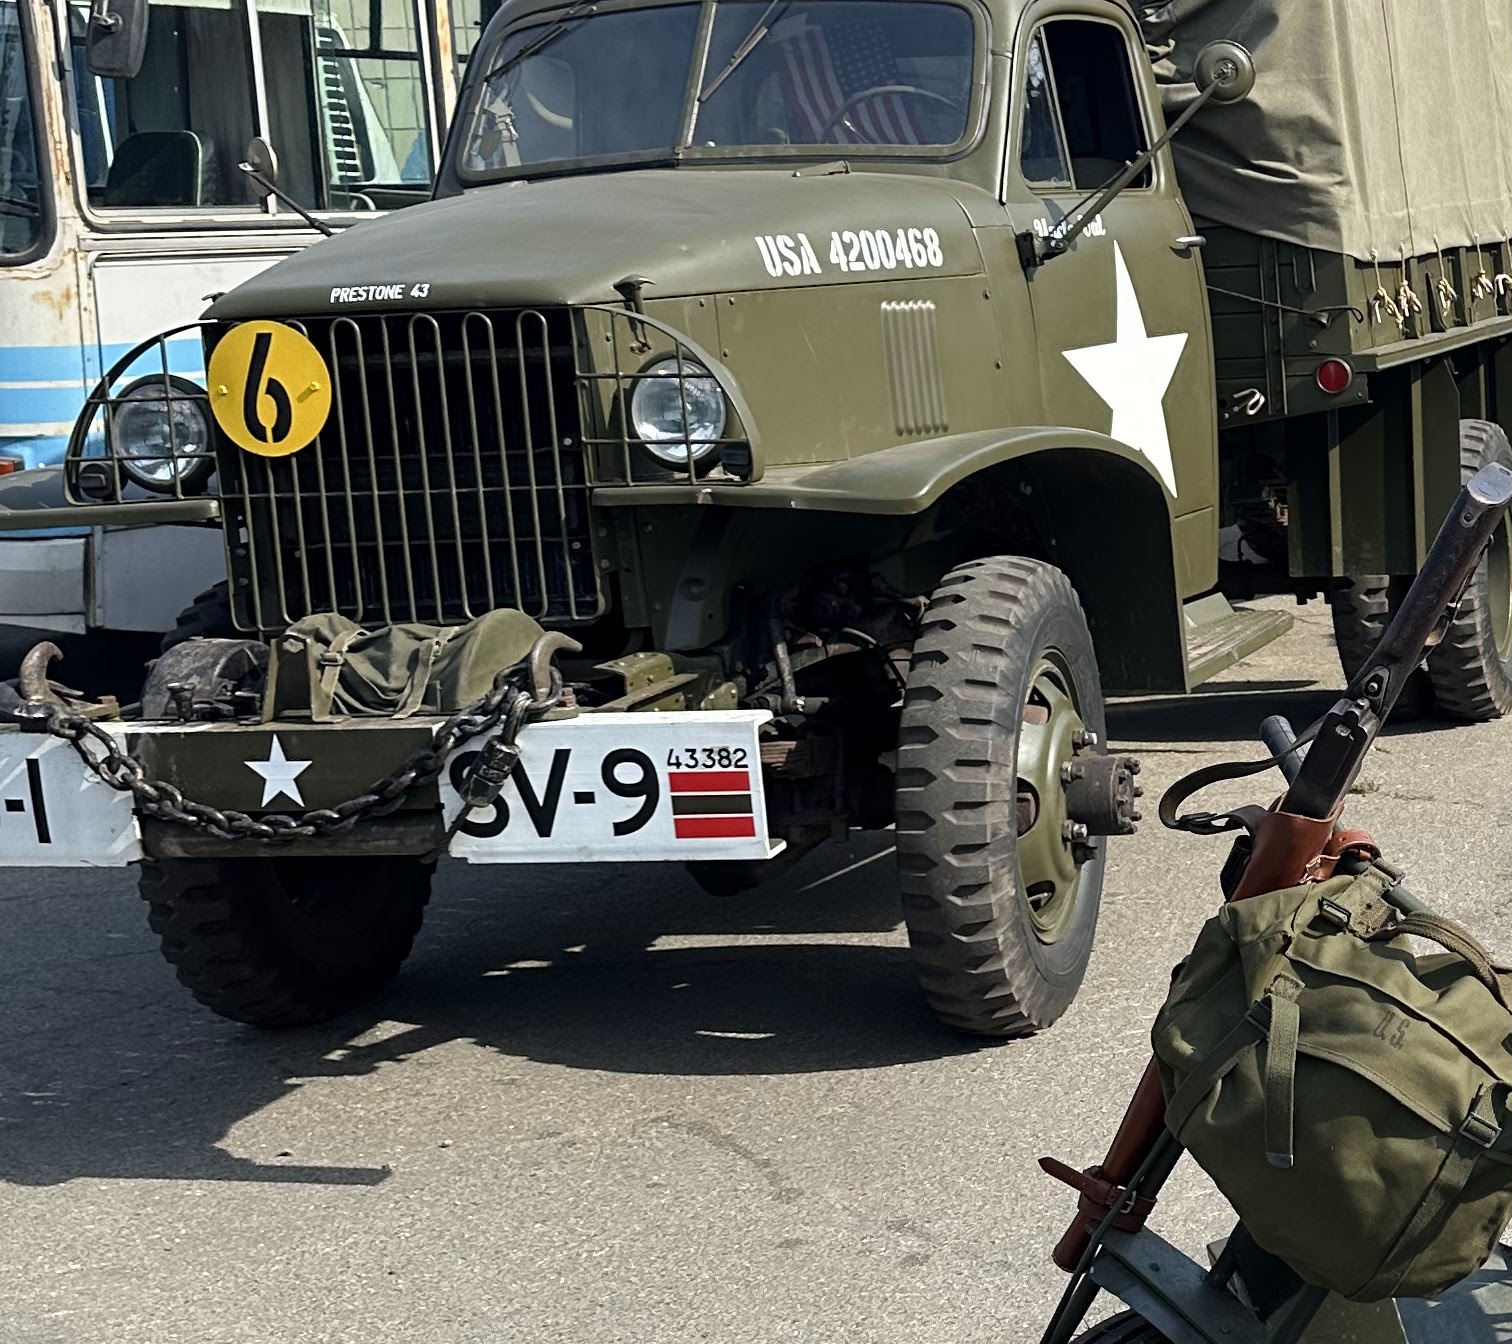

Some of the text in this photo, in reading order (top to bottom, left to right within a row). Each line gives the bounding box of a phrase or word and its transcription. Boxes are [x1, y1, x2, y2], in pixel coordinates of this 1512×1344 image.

[754, 228, 944, 277] USA 4200468
[330, 284, 430, 303] PRESTONE 43
[243, 332, 293, 444] 6
[667, 748, 748, 769] 43382
